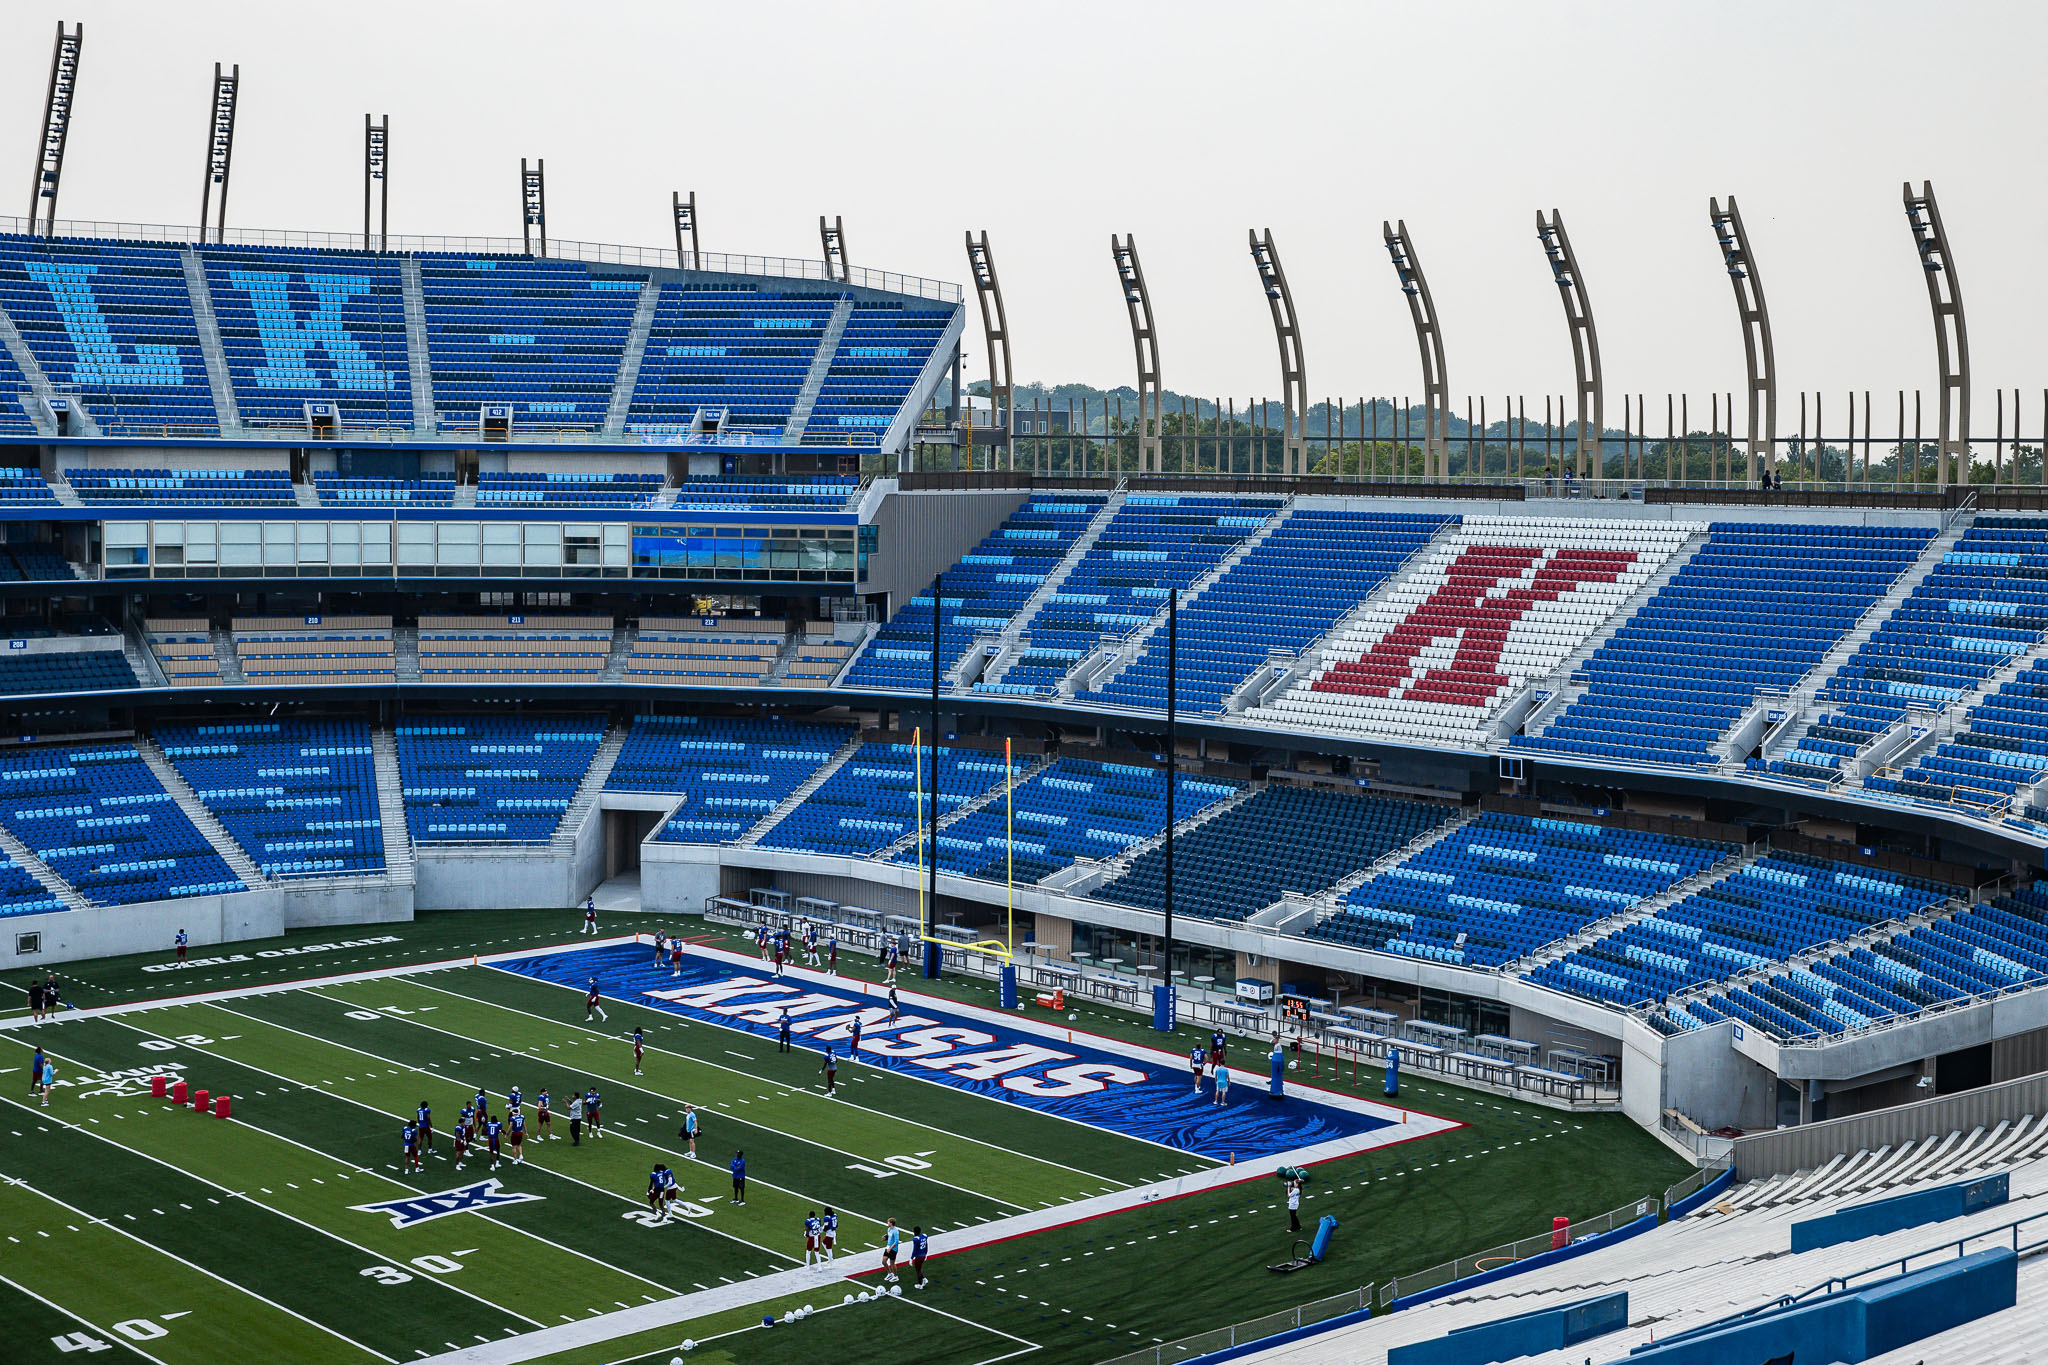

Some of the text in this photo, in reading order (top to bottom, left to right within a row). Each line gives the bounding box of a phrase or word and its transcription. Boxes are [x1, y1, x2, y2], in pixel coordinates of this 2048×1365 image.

[256, 935, 404, 958] KIVISTO
[141, 953, 254, 973] FIELD
[640, 976, 1149, 1098] KANSAS
[845, 1155, 932, 1178] 10
[359, 1255, 464, 1285] 30
[50, 1319, 169, 1353] 40
